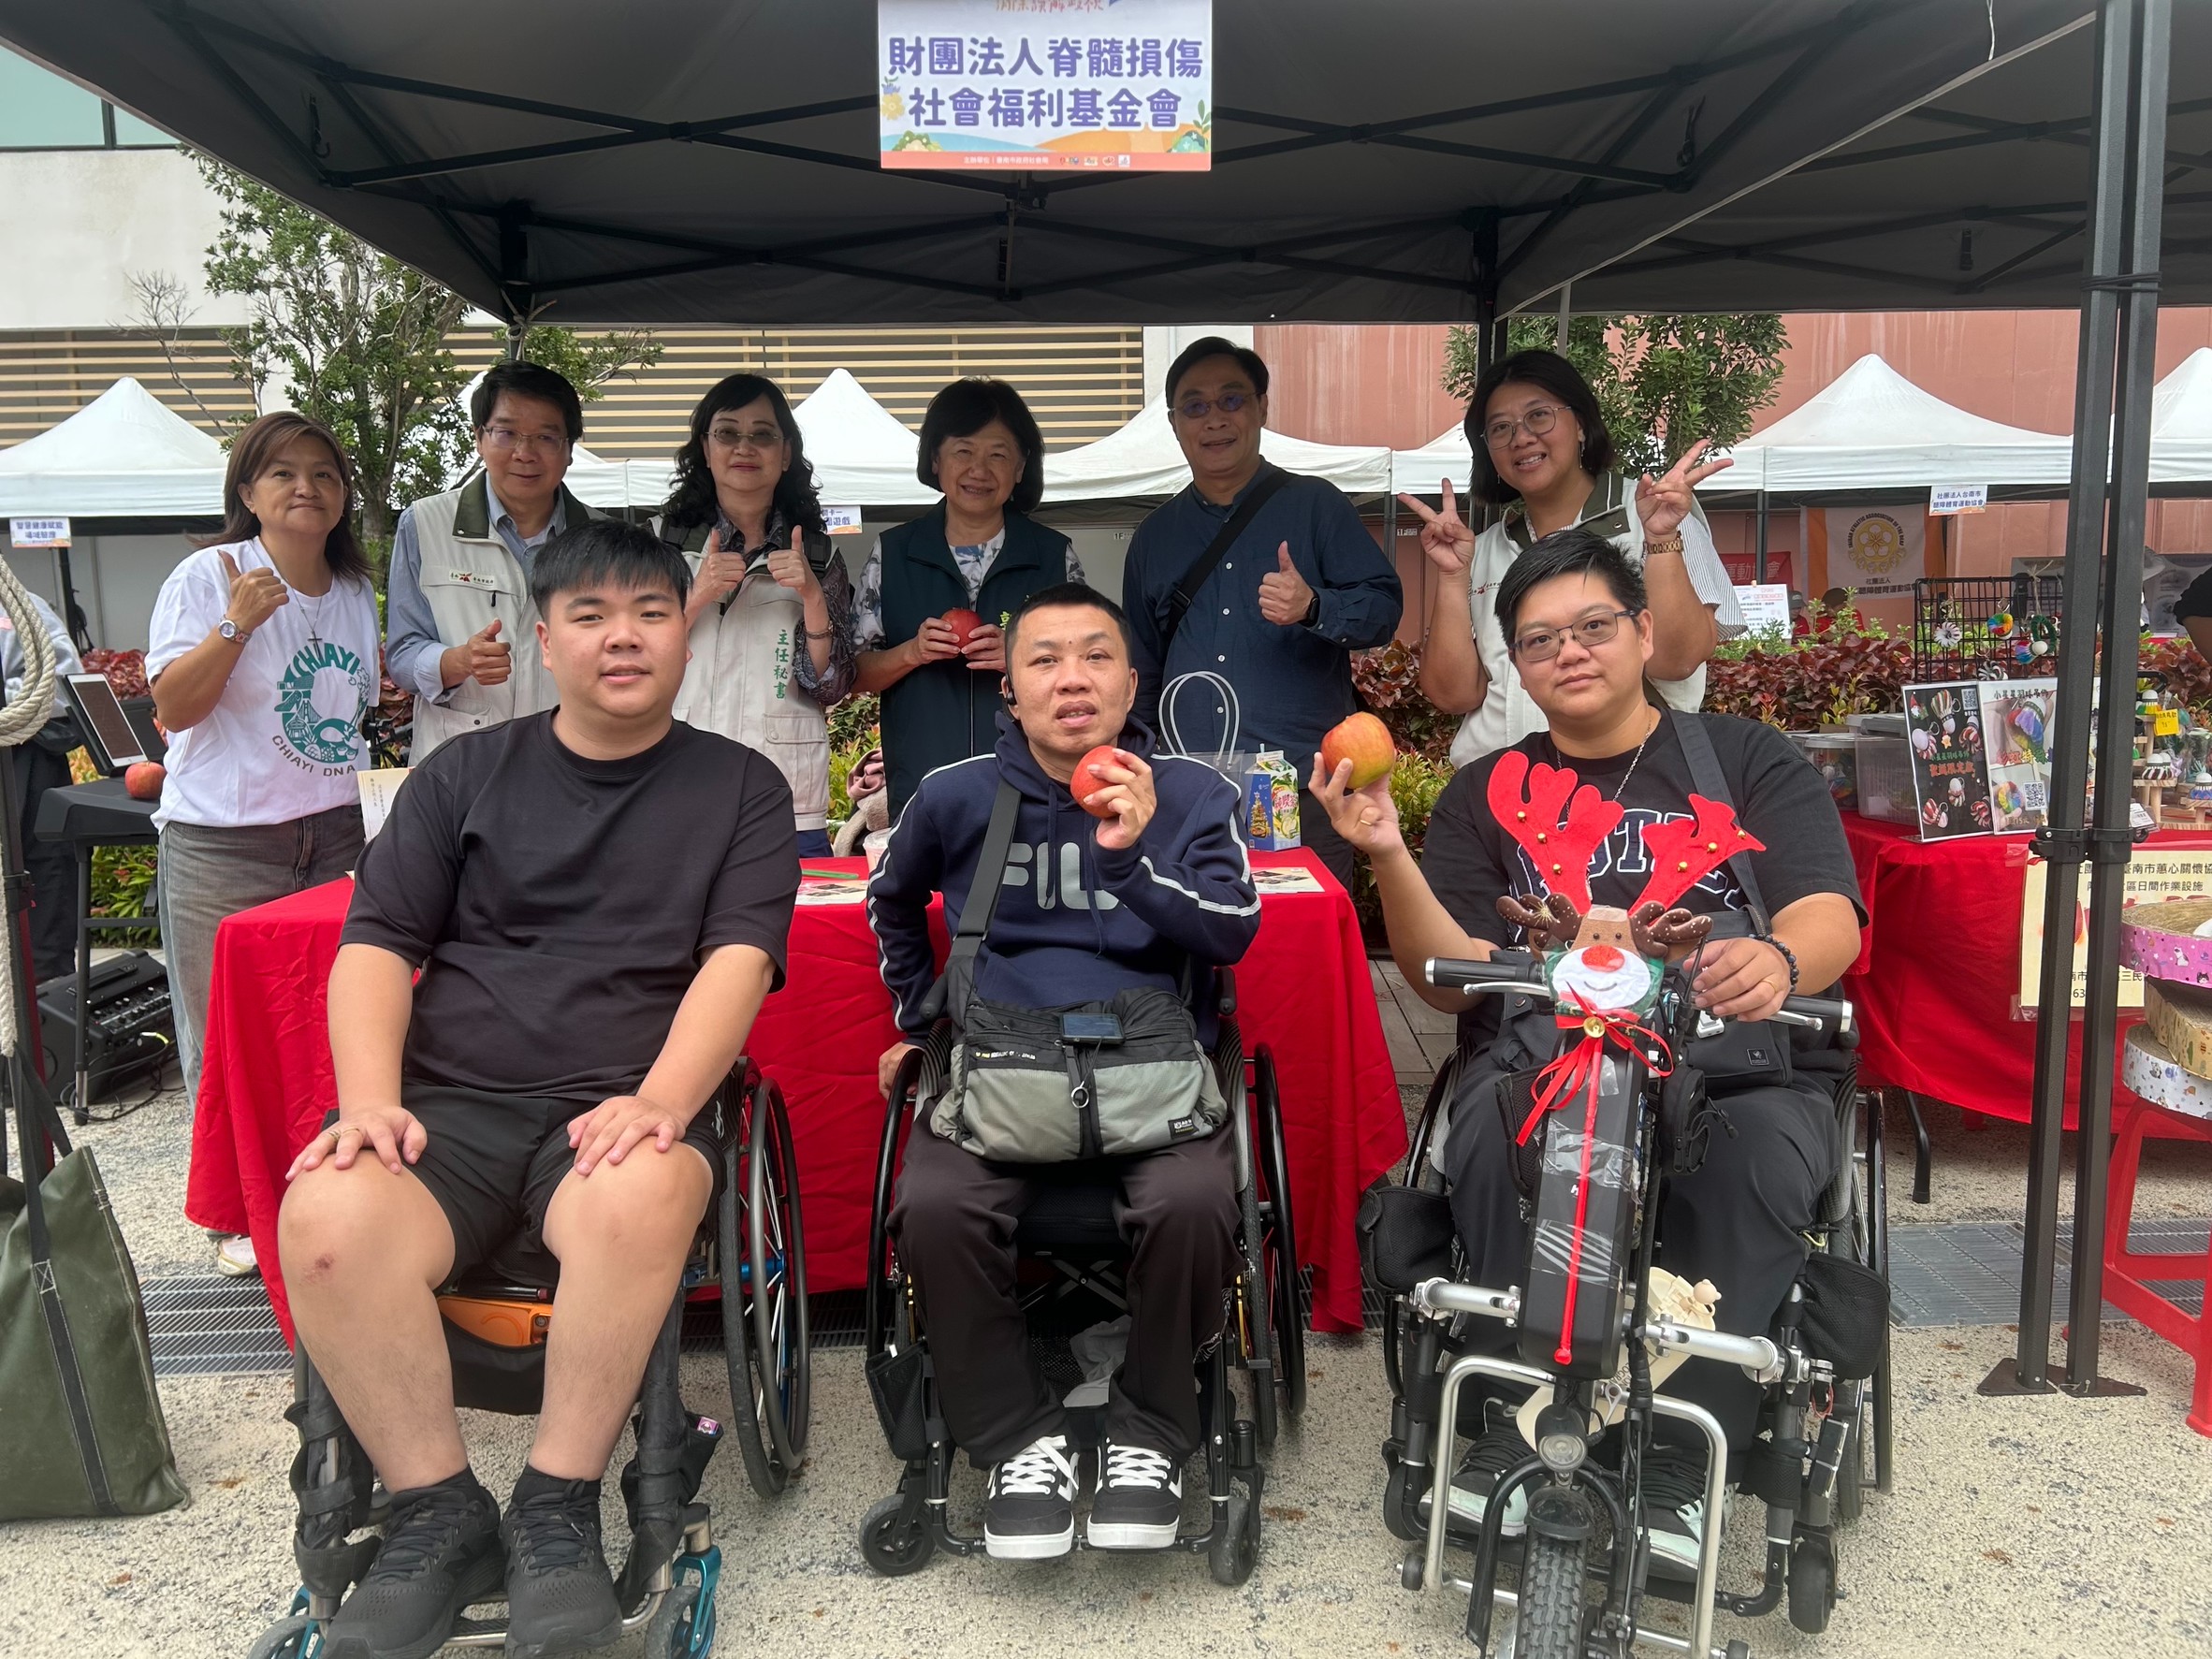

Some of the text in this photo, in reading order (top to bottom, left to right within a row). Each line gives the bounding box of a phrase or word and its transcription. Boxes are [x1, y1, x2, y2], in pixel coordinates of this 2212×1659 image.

[888, 36, 1203, 79] 財團法人脊髓損傷
[908, 87, 1183, 128] 社會福利基金會
[1726, 561, 1781, 582] 運動會
[271, 734, 357, 777] CHIAYI DNA
[1002, 841, 1120, 910] FIL
